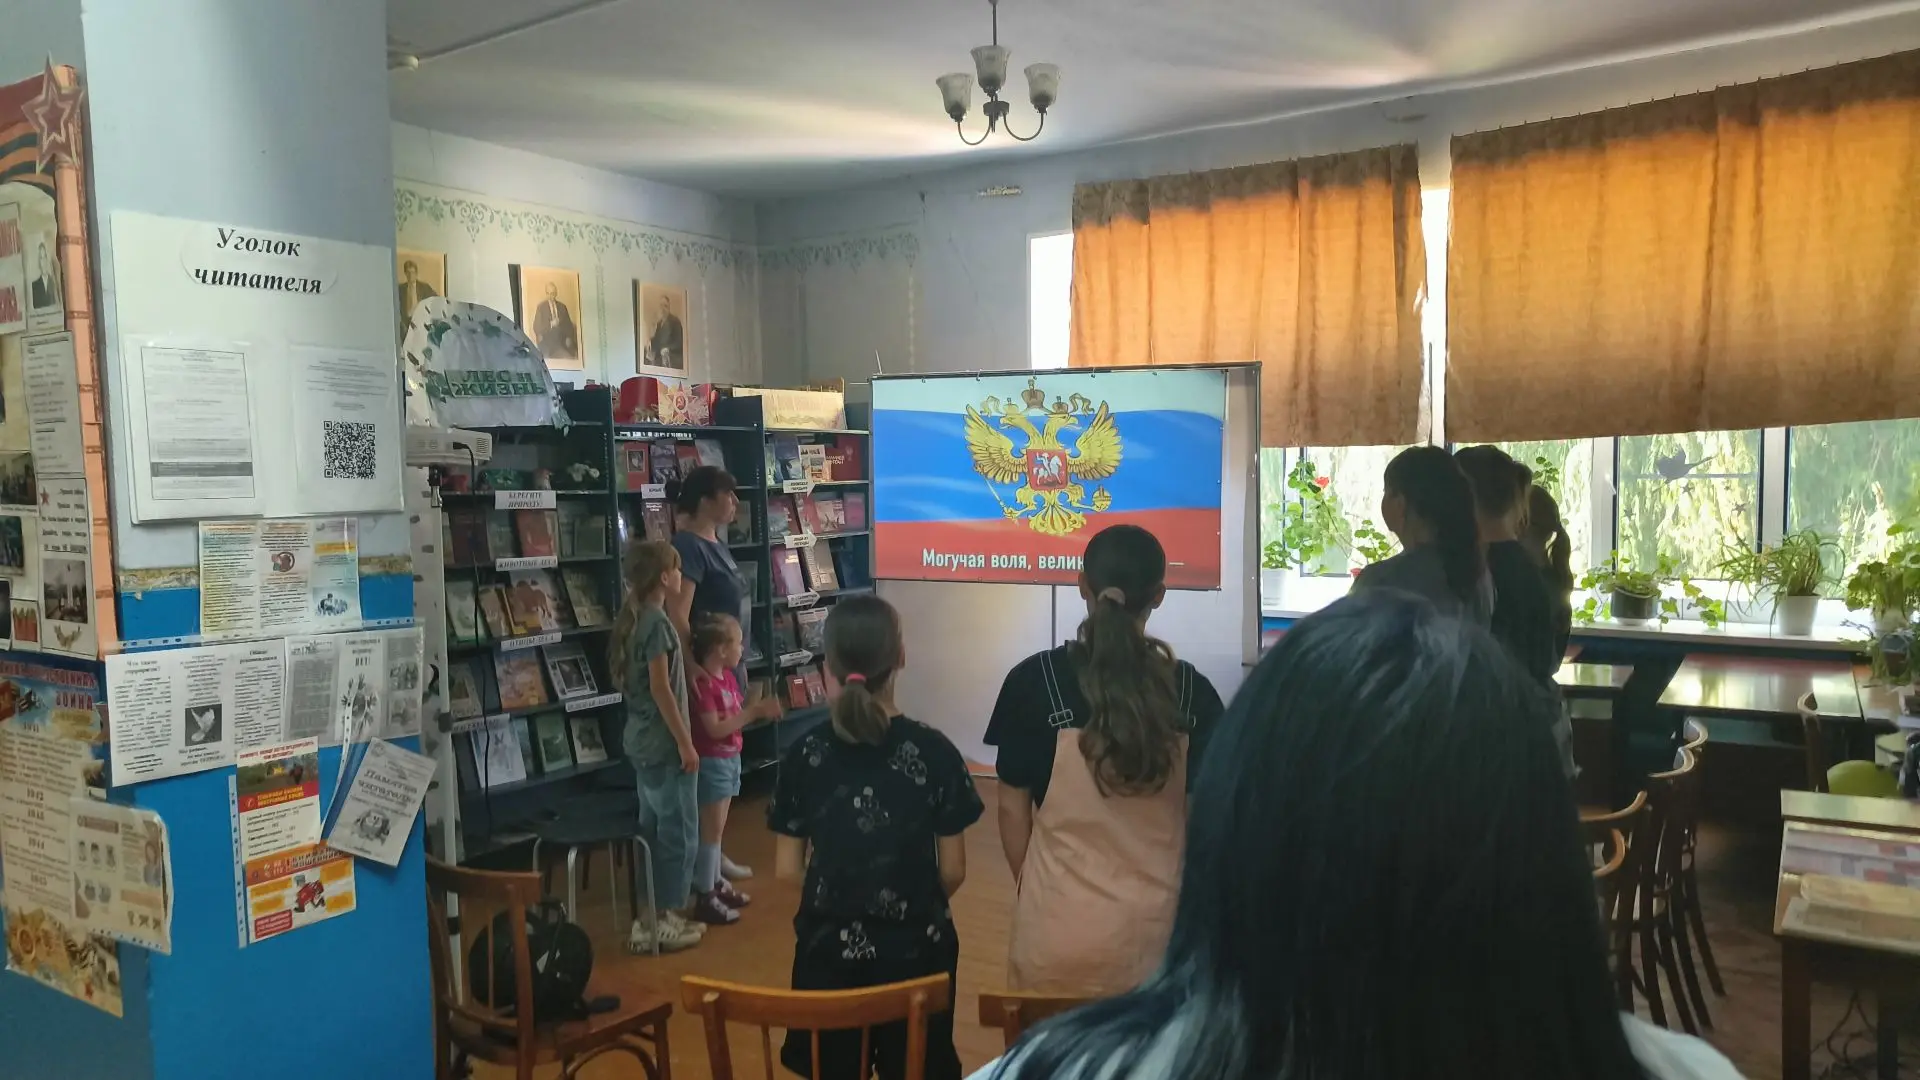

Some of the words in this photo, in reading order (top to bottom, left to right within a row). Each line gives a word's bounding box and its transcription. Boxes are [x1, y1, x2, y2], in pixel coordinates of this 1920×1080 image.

[216, 227, 301, 257] Уголок
[194, 268, 322, 294] читателя
[463, 370, 512, 383] ЛЕС
[451, 382, 548, 396] ЖИЗНЬ
[922, 547, 985, 569] Могучая
[991, 554, 1031, 570] воля,
[1038, 555, 1085, 570] велик
